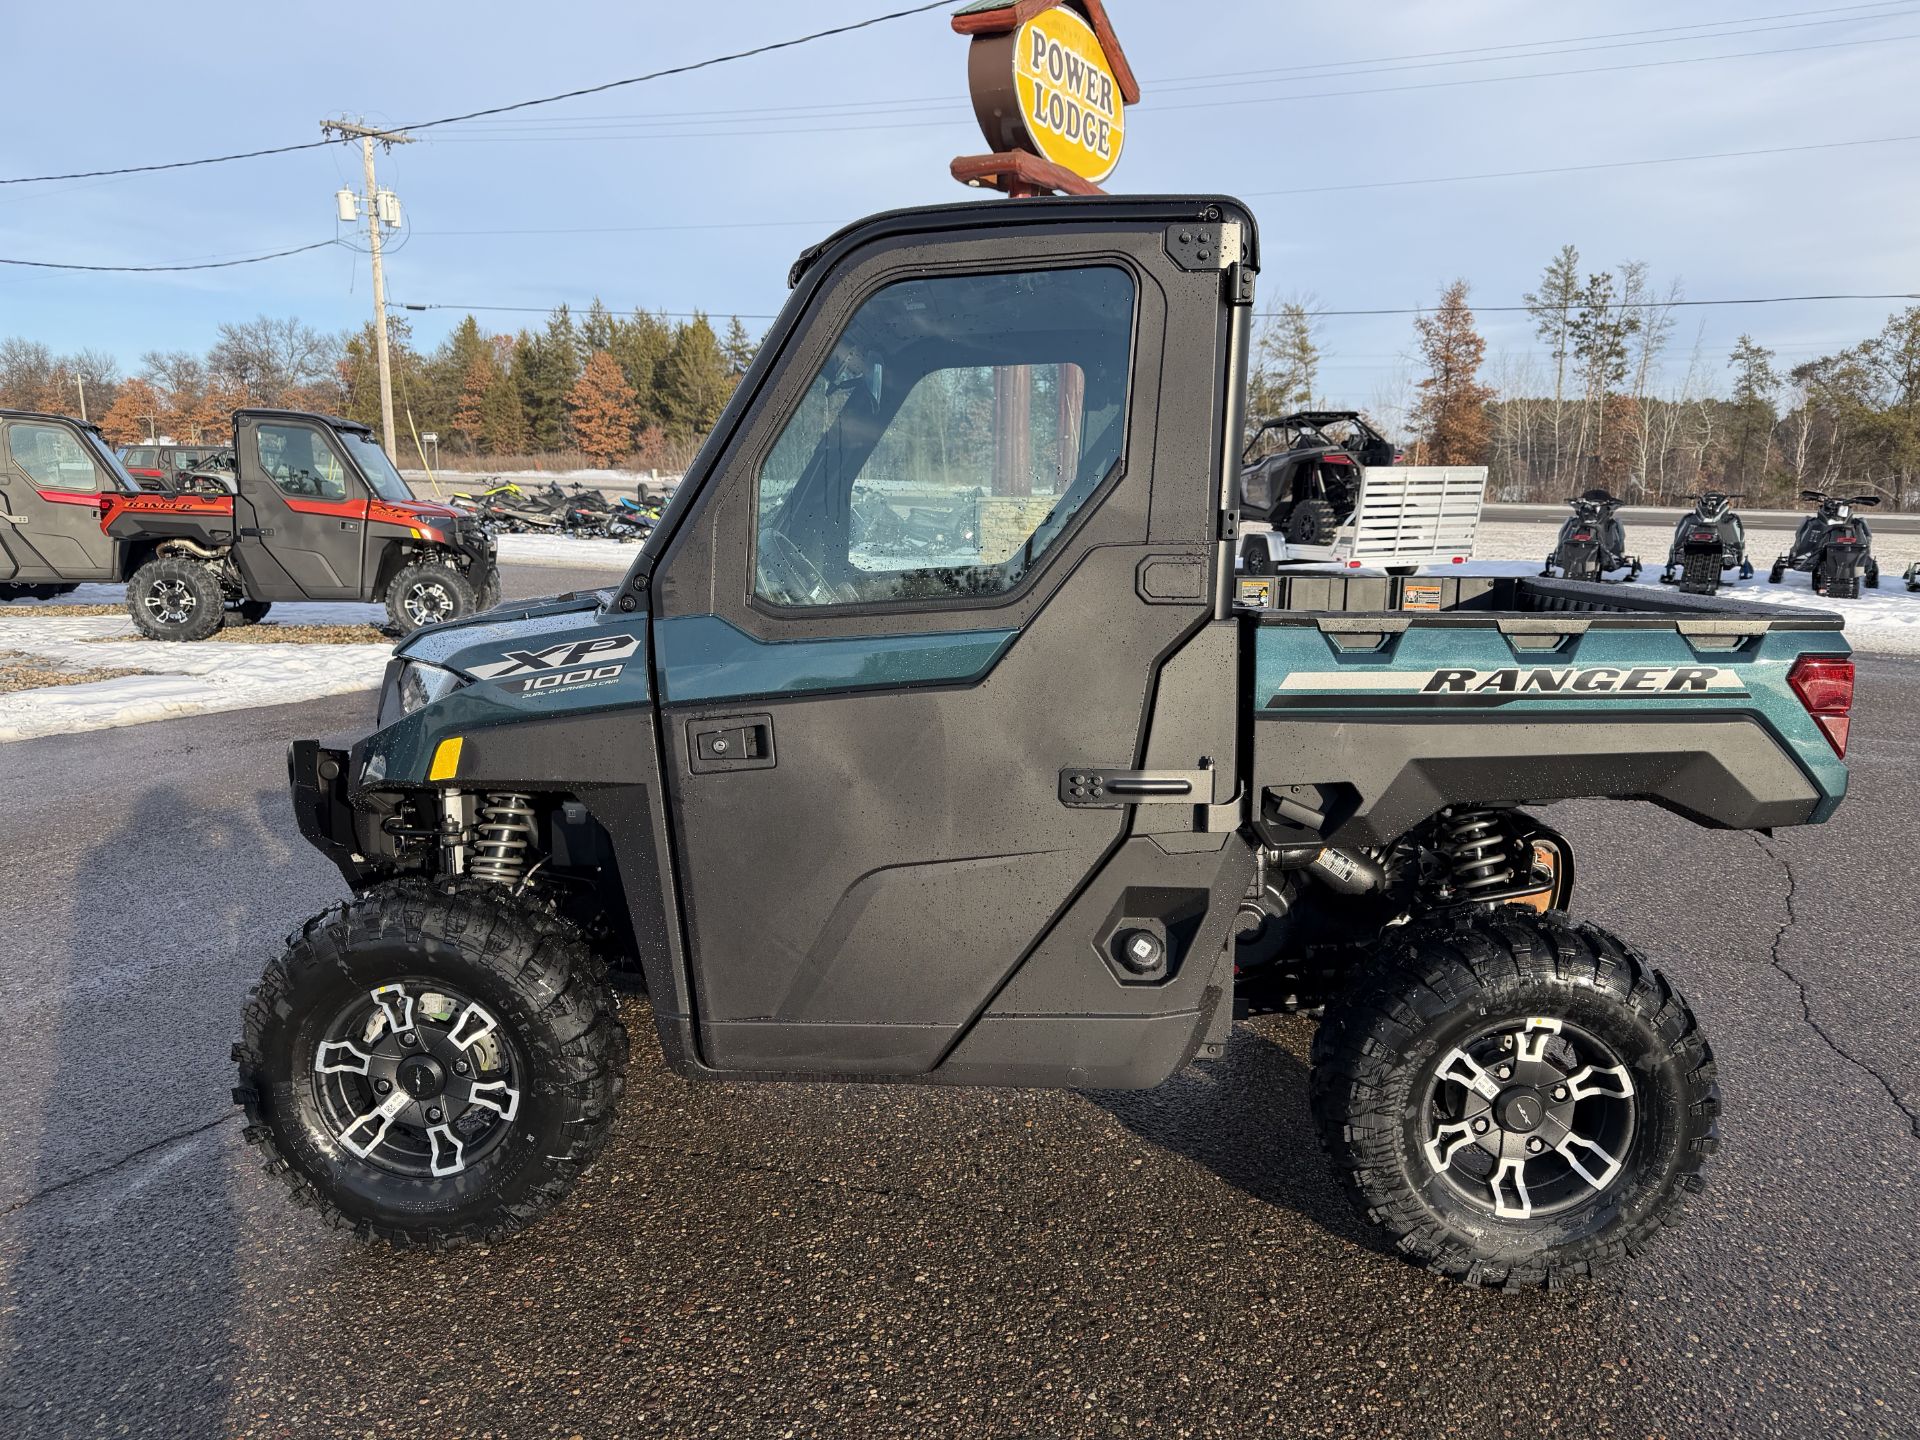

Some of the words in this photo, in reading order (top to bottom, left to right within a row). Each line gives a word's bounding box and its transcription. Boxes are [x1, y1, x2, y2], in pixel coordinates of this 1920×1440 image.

[1031, 29, 1113, 116] POWER
[1034, 81, 1110, 157] LODGE
[127, 502, 193, 510] RANGER
[487, 634, 637, 678] XP
[522, 664, 623, 691] 1000
[548, 682, 597, 694] OVERHEAD
[598, 678, 619, 686] CAM
[1420, 667, 1719, 694] RANGER
